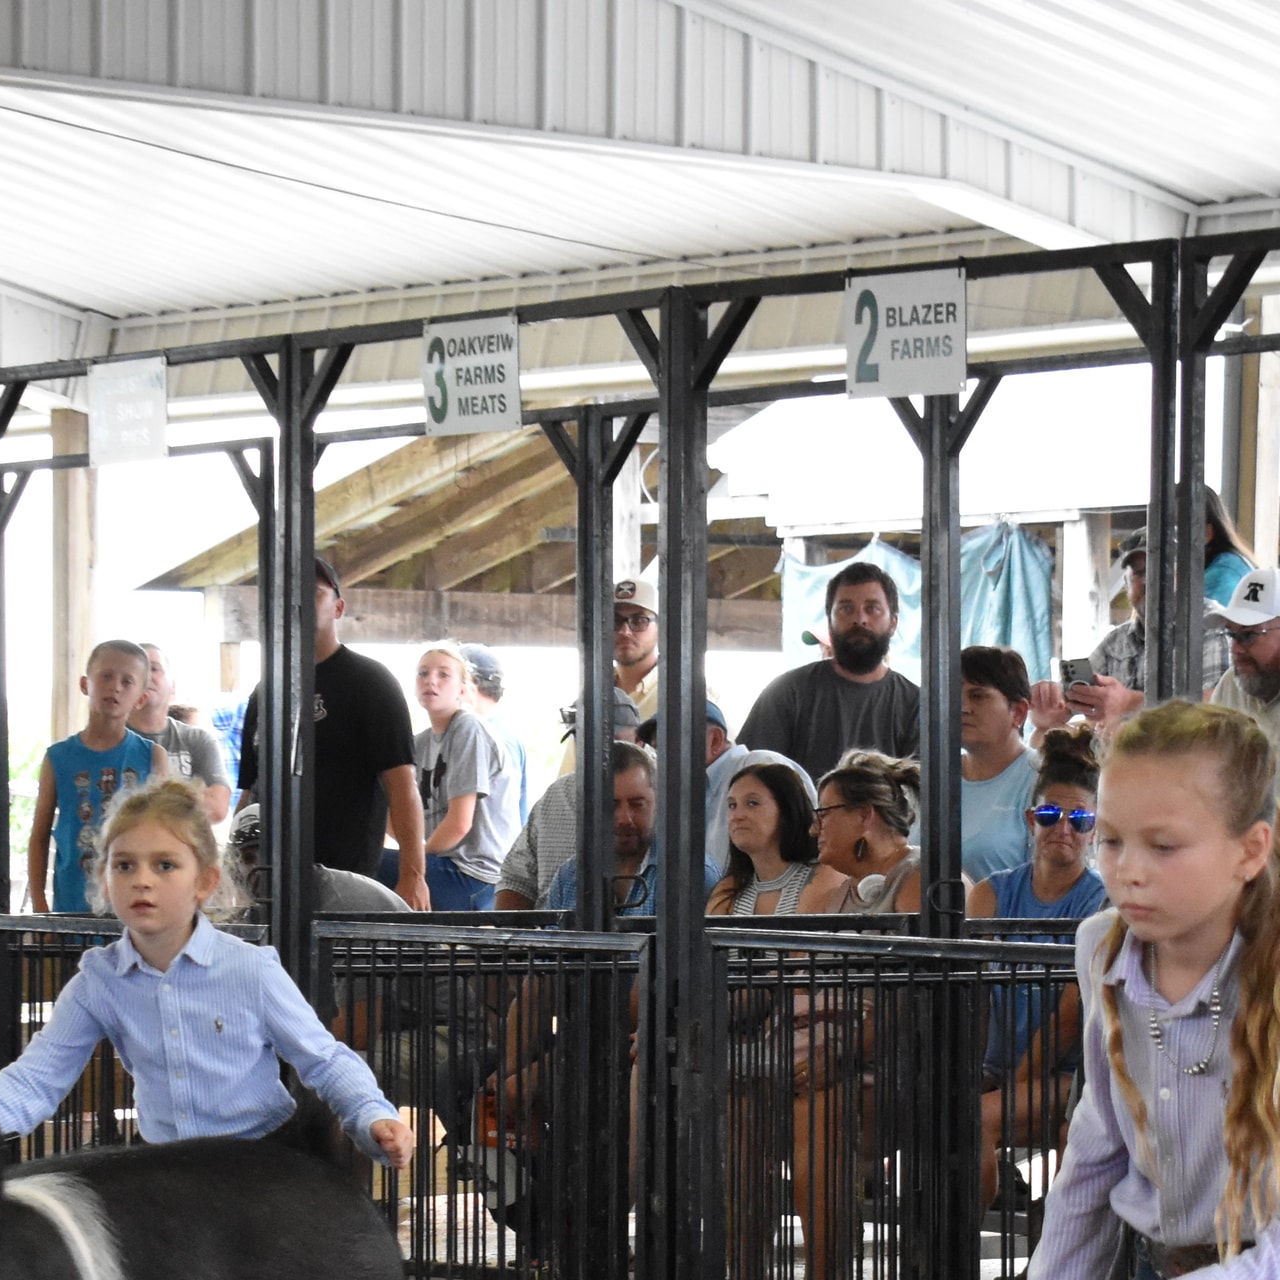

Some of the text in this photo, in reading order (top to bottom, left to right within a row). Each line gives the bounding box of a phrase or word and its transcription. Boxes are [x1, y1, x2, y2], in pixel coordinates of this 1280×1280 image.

[886, 302, 957, 328] BLAZER
[447, 333, 514, 358] OAKVEIW
[855, 289, 879, 383] 2
[891, 335, 953, 360] FARMS
[427, 336, 448, 424] 3
[455, 363, 506, 387] FARMS
[458, 393, 508, 417] MEATS
